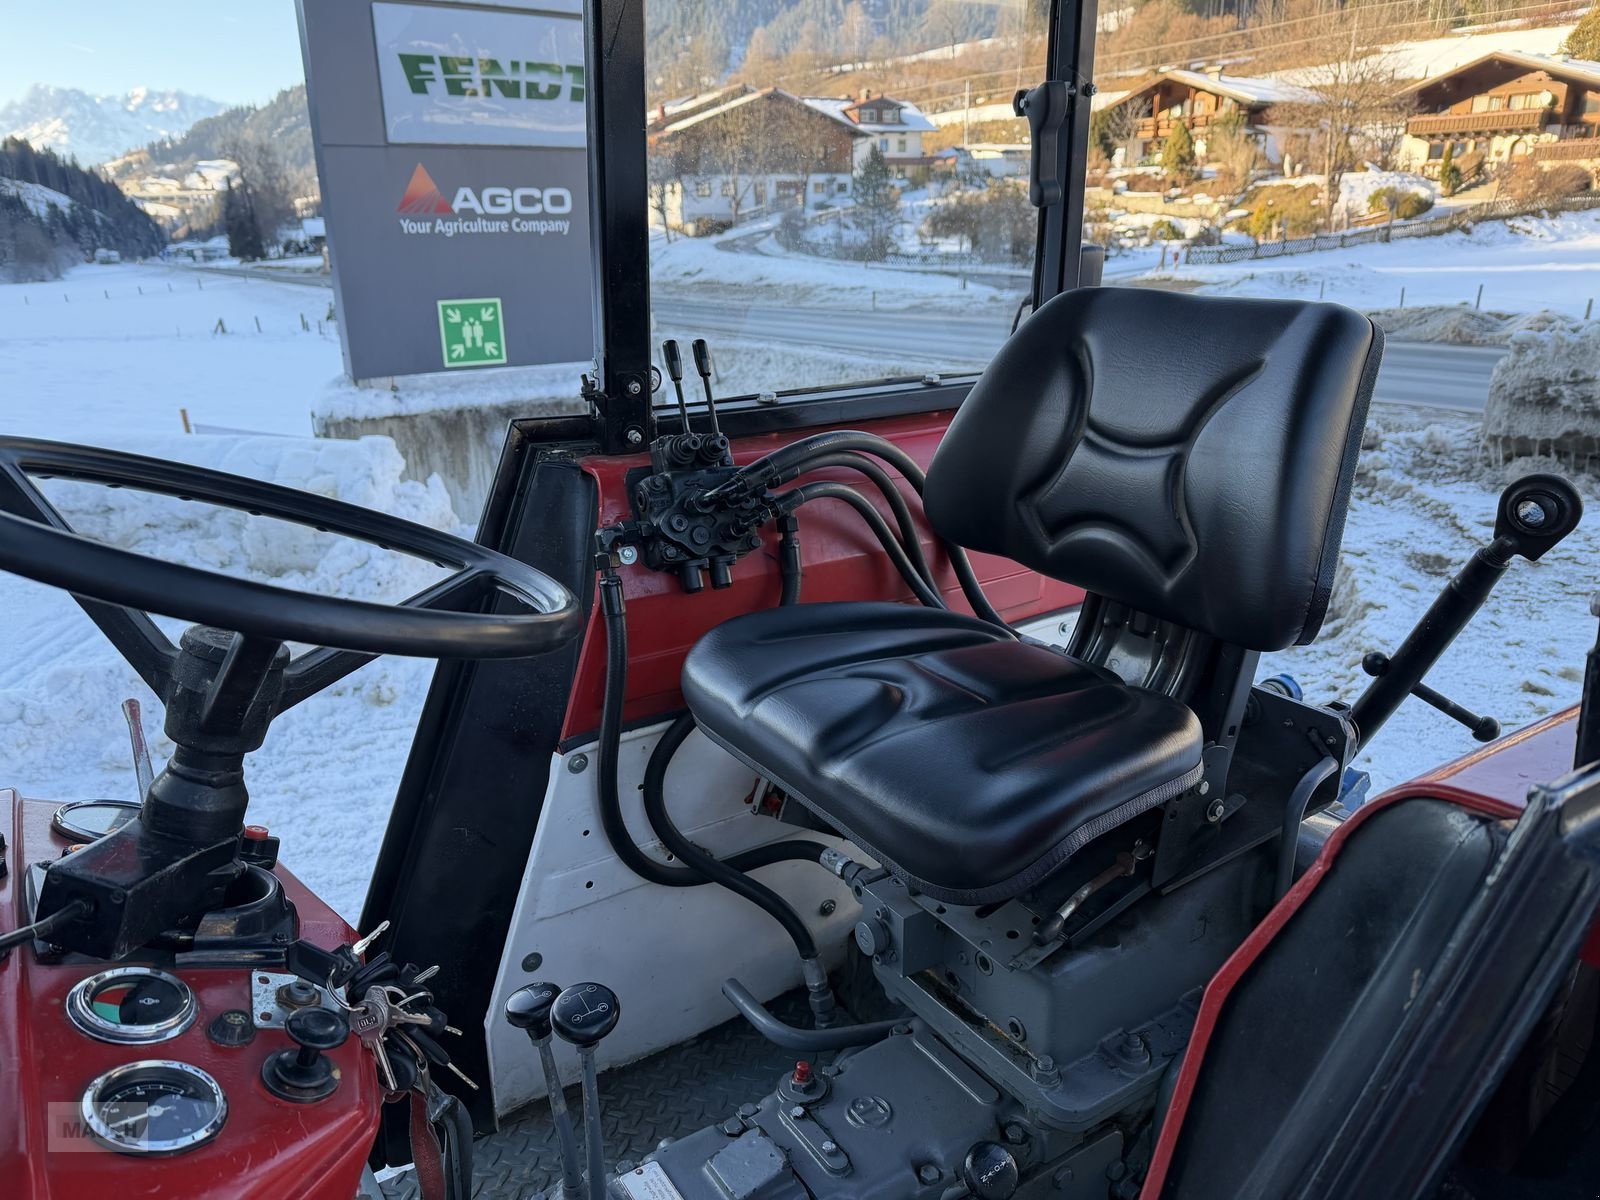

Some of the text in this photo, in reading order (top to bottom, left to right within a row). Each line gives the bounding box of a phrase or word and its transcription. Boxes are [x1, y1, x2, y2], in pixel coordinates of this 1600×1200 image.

[451, 187, 572, 214] AGCO
[400, 217, 570, 237] Your Agriculture Company
